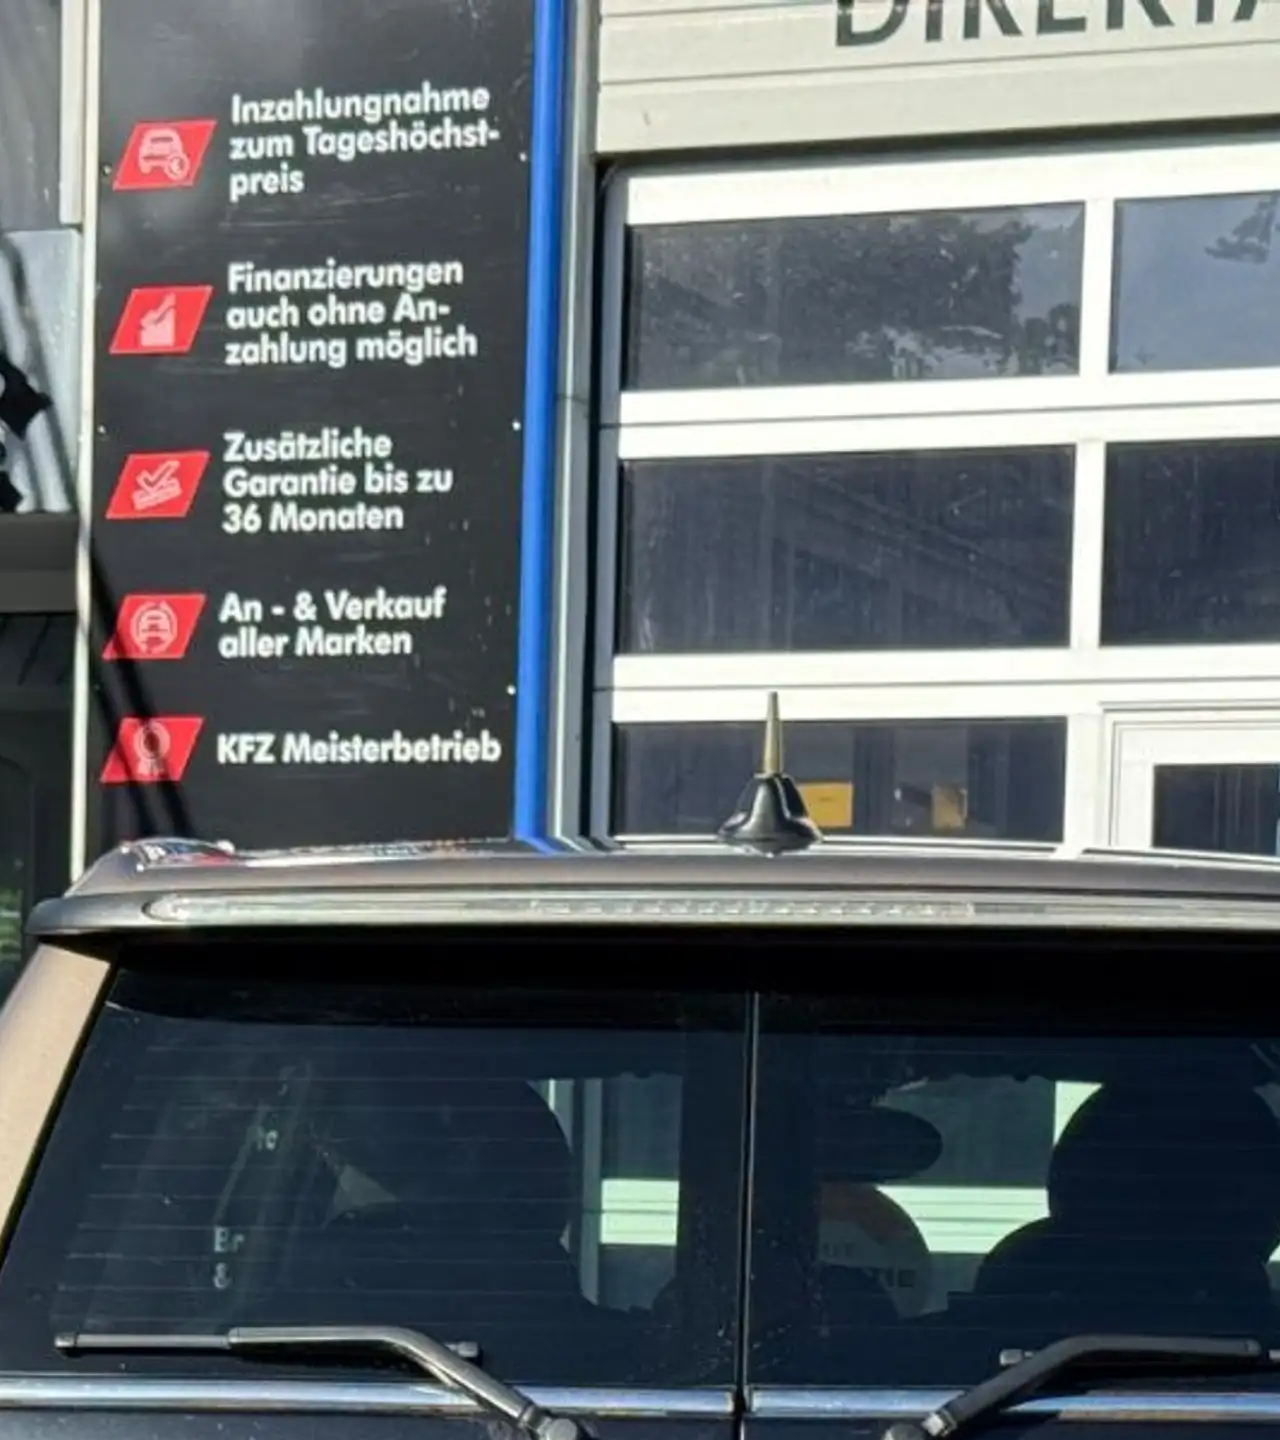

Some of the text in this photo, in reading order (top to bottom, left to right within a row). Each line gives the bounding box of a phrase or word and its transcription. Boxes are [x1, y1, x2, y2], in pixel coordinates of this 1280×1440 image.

[232, 81, 490, 124] Inzahlungnahme
[230, 119, 499, 161] zum Tageshöchst-
[230, 164, 304, 201] preis
[228, 258, 462, 291] Finanzierungen
[227, 292, 450, 329] auch ohne An-
[225, 326, 477, 367] zahlung möglich
[223, 427, 391, 462] Zusätzliche
[223, 464, 452, 498] Garantie bis zu
[223, 504, 403, 533] 36 Monaten
[219, 592, 262, 623] An
[294, 595, 316, 619] &
[326, 586, 446, 619] Verkauf
[219, 627, 412, 658] aller Marken
[217, 730, 501, 763] KFZ Meisterbetrieb
